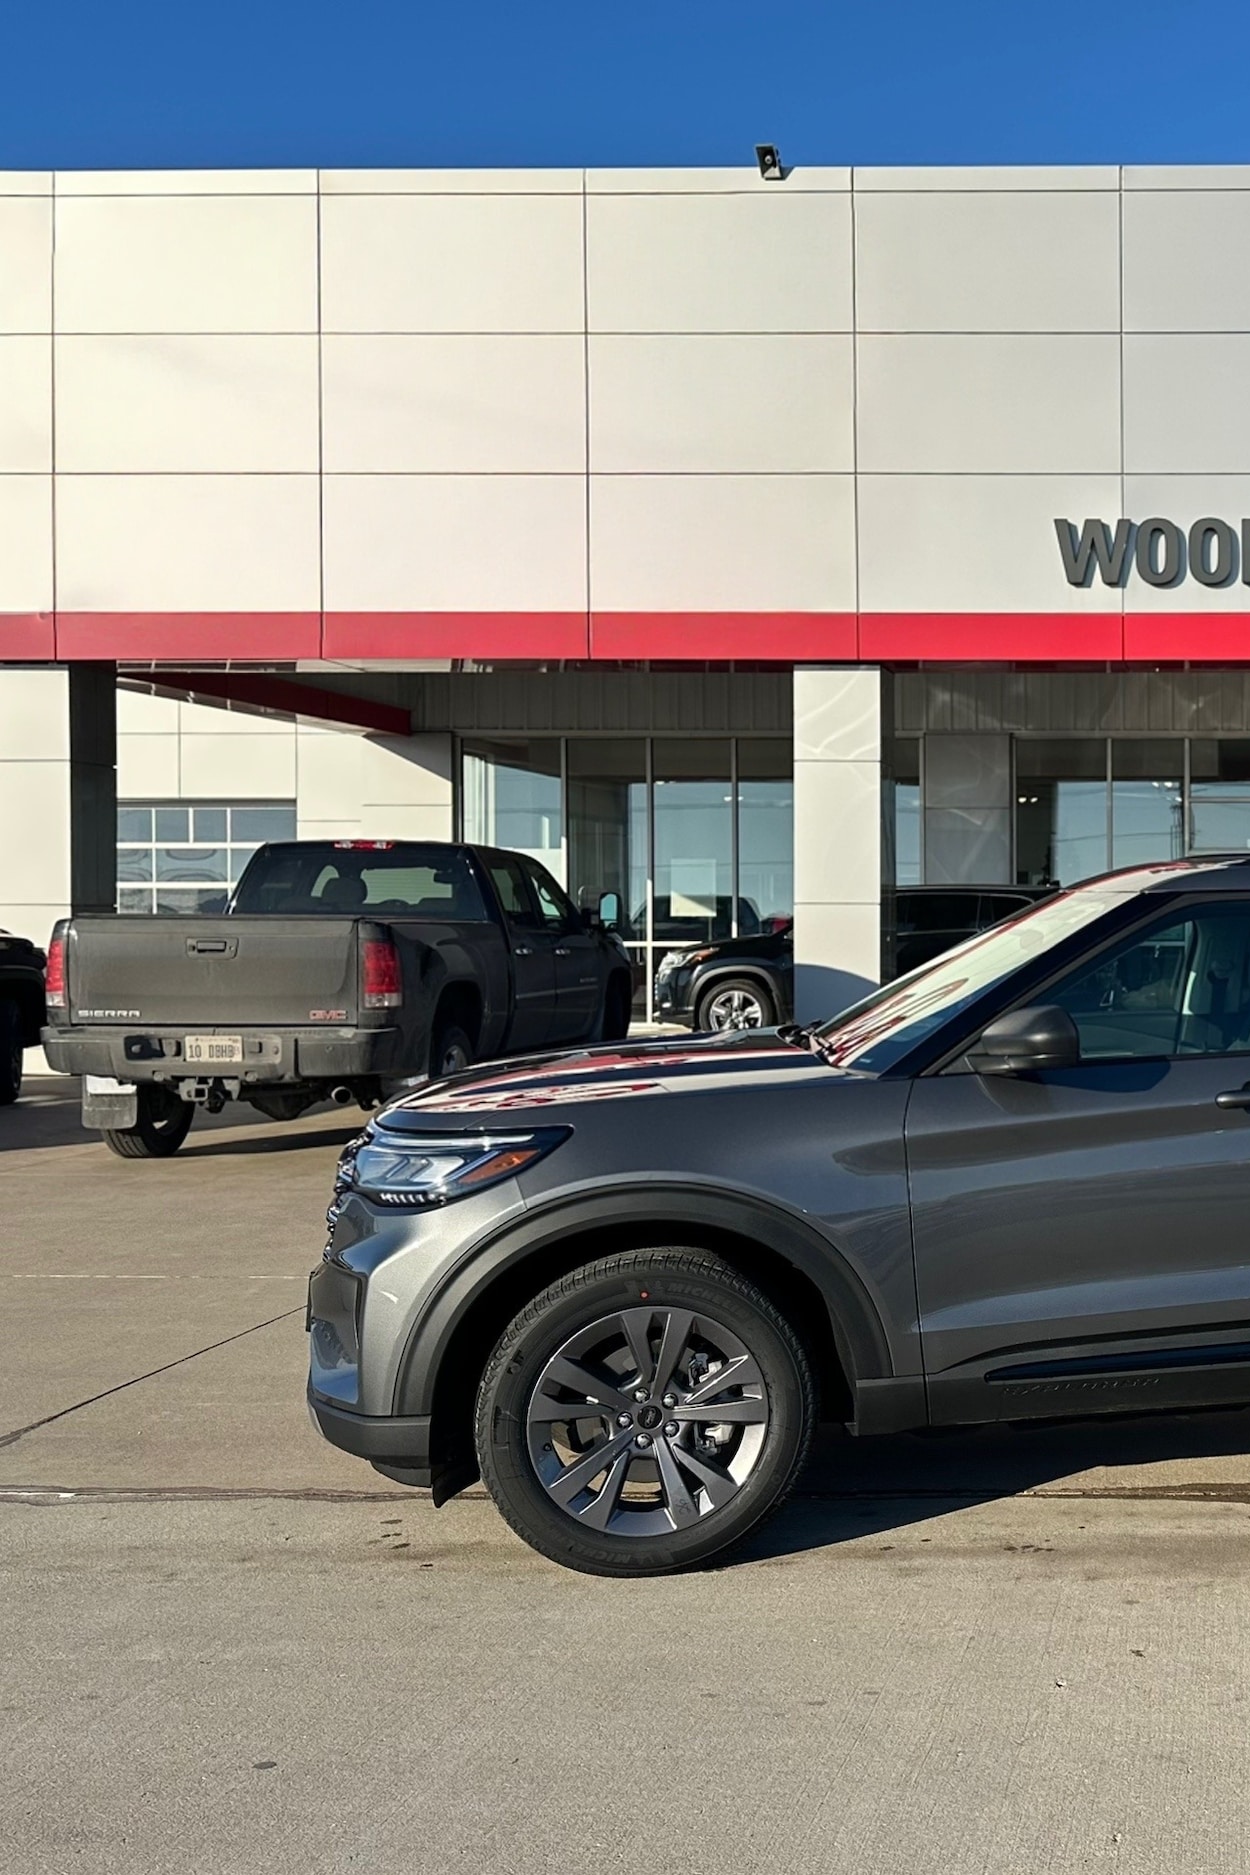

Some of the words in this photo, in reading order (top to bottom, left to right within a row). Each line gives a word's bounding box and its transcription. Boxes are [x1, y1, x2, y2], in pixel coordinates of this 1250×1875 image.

[78, 1009, 140, 1018] SIERRA
[309, 1009, 347, 1020] GMC
[188, 1044, 202, 1059] 10
